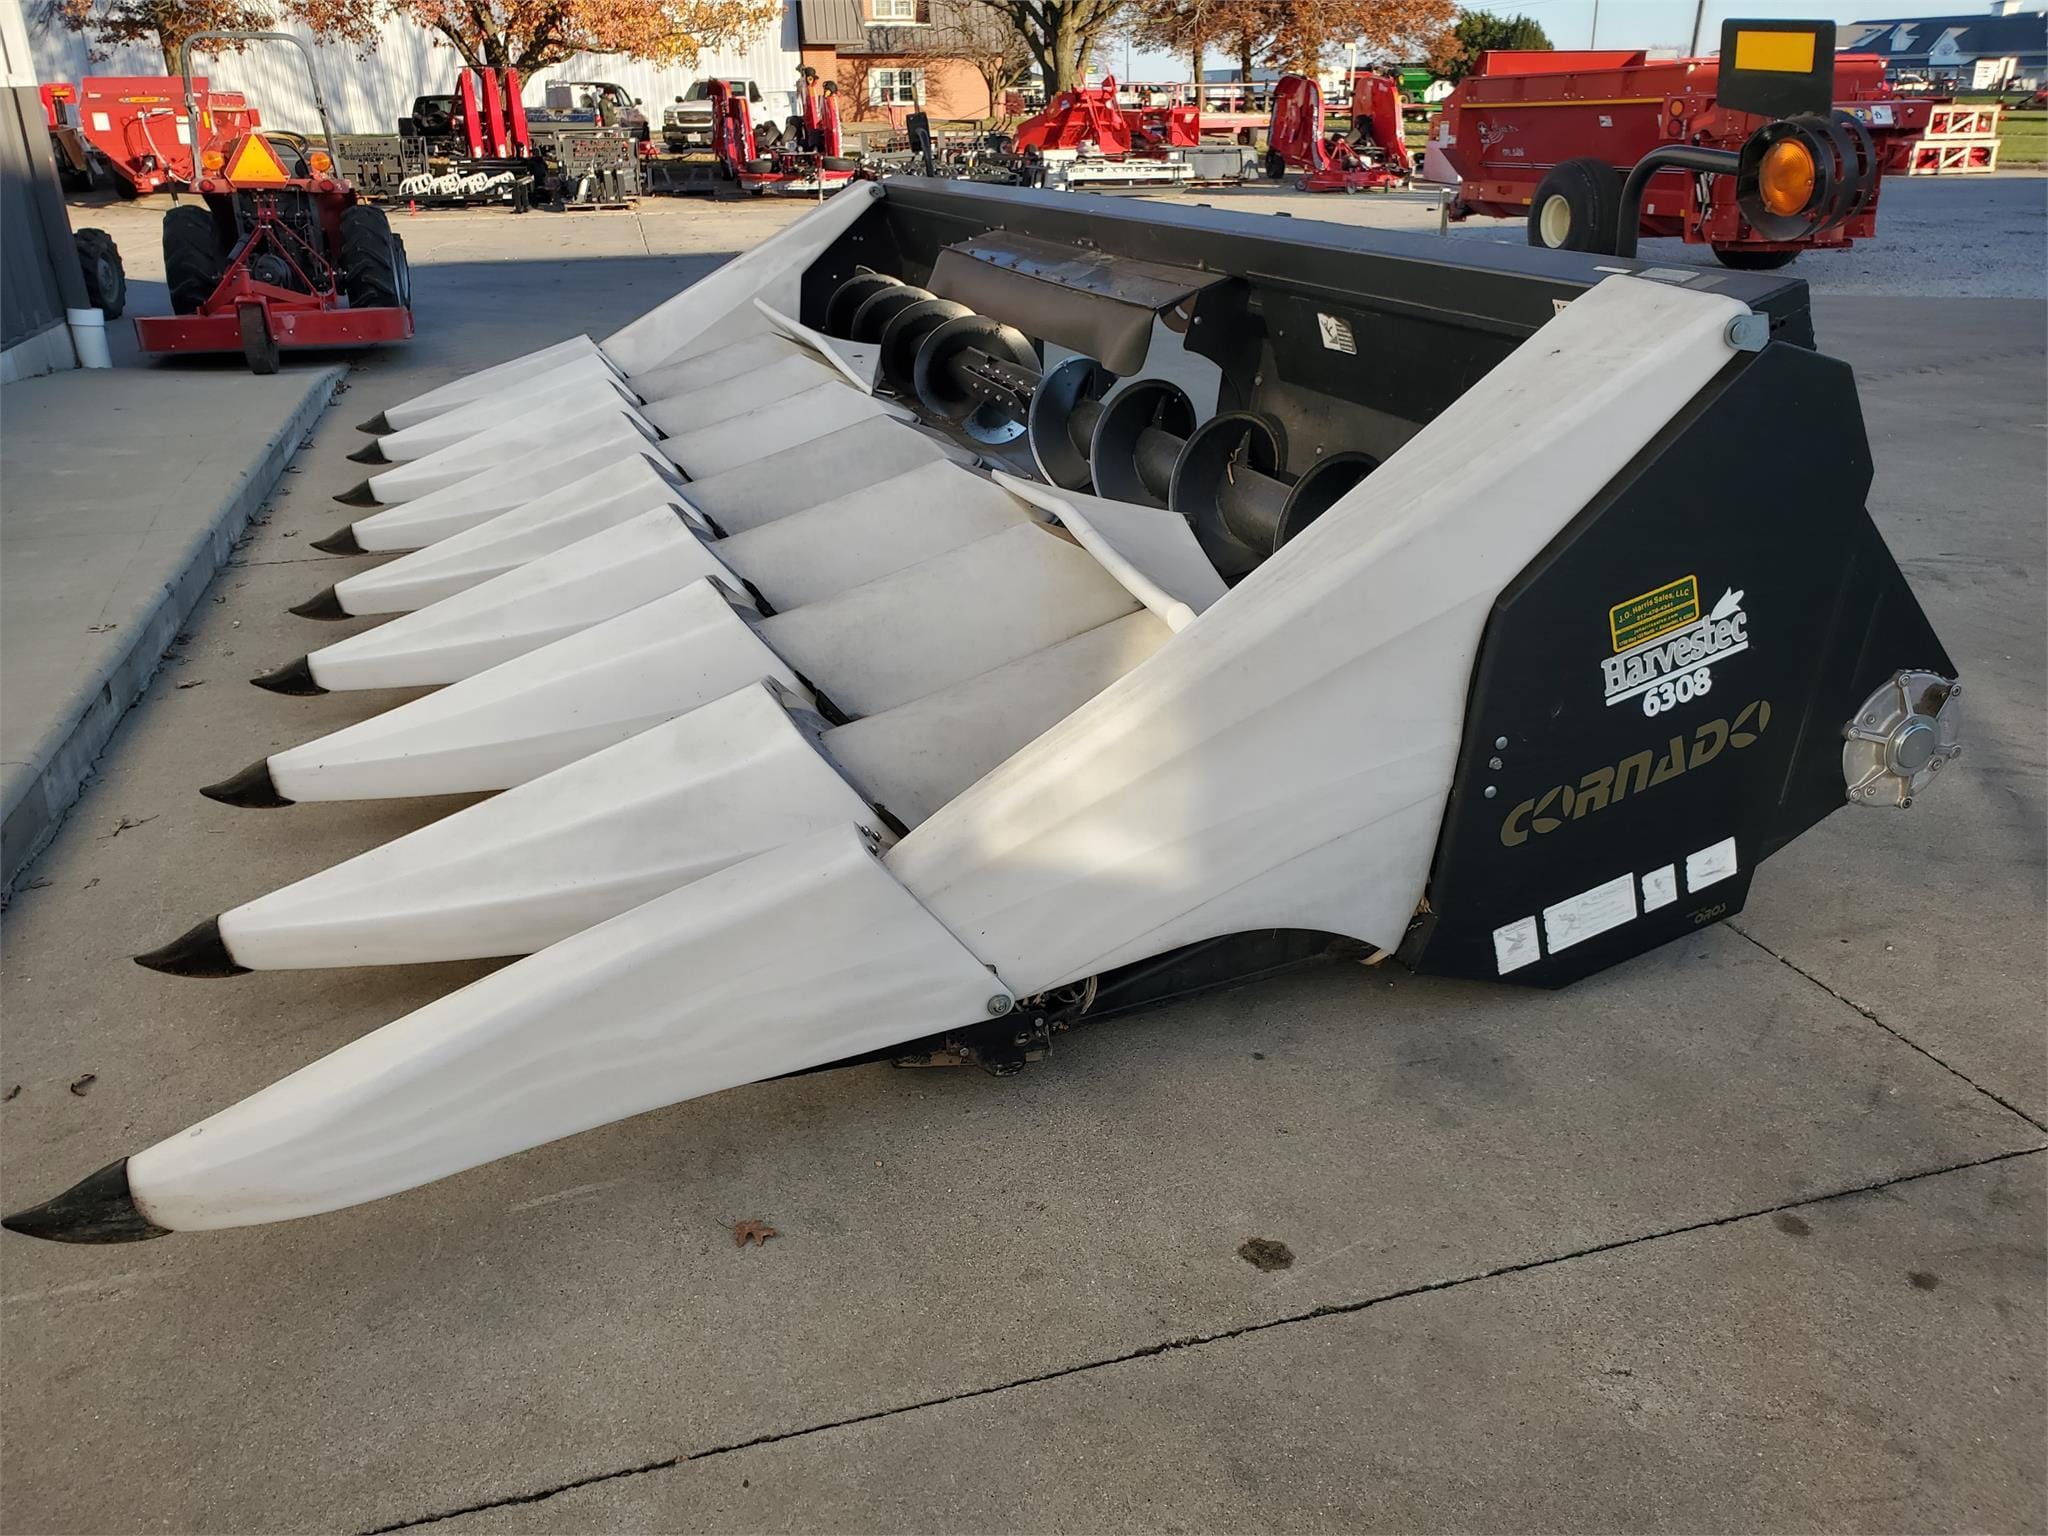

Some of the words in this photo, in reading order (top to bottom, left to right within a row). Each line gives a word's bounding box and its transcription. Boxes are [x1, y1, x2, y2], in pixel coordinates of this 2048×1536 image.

[1632, 598, 1653, 614] Harris
[1675, 588, 1690, 598] LLC
[1601, 611, 1748, 697] Harvestec
[1642, 667, 1712, 717] 6308
